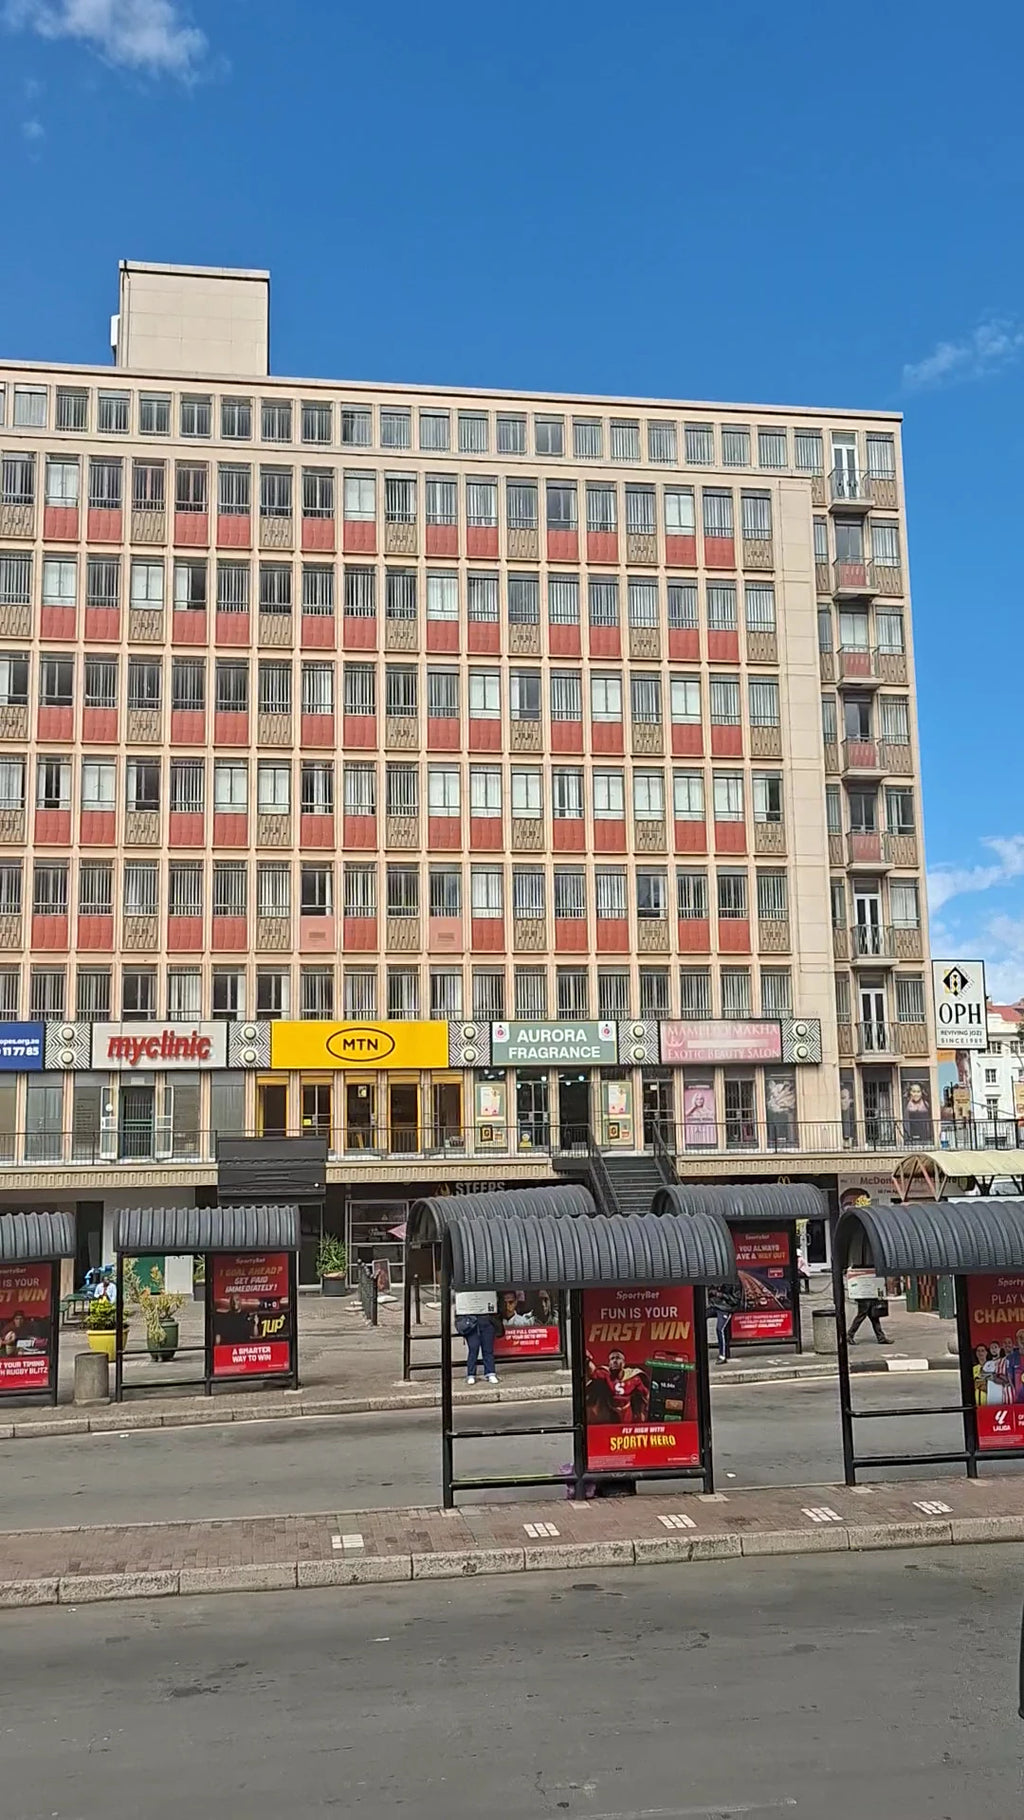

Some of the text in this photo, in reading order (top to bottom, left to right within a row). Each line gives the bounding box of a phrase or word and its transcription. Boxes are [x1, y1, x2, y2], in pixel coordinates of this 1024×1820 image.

[939, 1003, 981, 1024] OPH
[517, 1029, 587, 1043] AURORA
[969, 1030, 982, 1038] JOZI
[107, 1030, 211, 1066] myclinic
[343, 1038, 378, 1051] MTN
[26, 1046, 39, 1056] 85
[508, 1046, 600, 1059] FRAGRANCE
[668, 1047, 780, 1060] EXOTIC BEAUTY SALON
[248, 1266, 283, 1276] AHEAD?
[15, 1278, 39, 1287] YOUR
[234, 1276, 269, 1285] GET PAID
[225, 1284, 278, 1293] IMMEDIATELY!
[18, 1288, 48, 1302] WIN
[616, 1290, 660, 1300] SportyBet
[991, 1294, 1017, 1304] PLAY
[601, 1306, 678, 1320] FUN IS YOUR
[589, 1321, 690, 1342] FIRST WIN
[238, 1346, 271, 1354] SMARTER
[232, 1355, 246, 1363] WAY
[29, 1366, 48, 1375] BLITZ
[610, 1435, 676, 1451] SPORTY HERO
